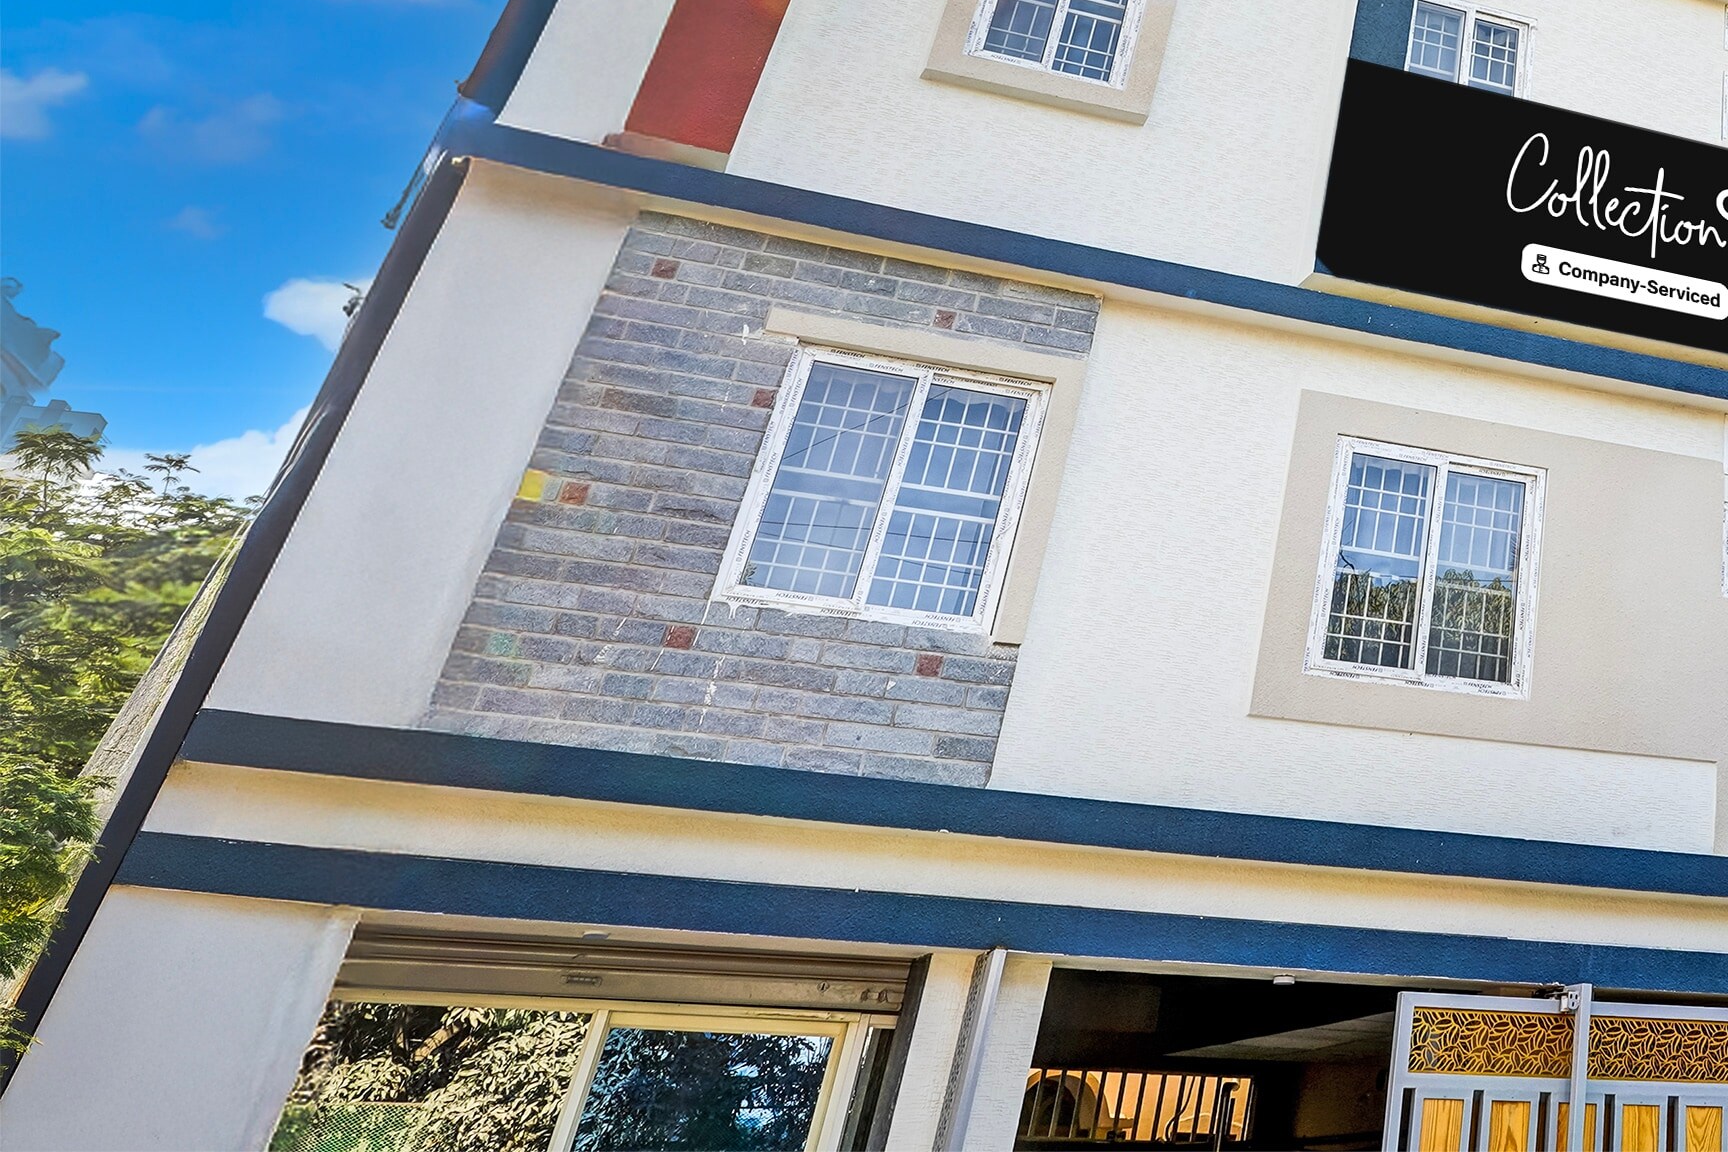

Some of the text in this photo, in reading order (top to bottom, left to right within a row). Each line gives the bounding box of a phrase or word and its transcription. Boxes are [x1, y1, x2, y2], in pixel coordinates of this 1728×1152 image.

[1506, 132, 1727, 259] Collection
[1558, 261, 1721, 309] Company-Serviced
[787, 348, 800, 374] FENSTECH
[835, 349, 865, 358] FENSTECH
[874, 363, 903, 372] FENSTECH
[919, 363, 950, 373] FENSTECH
[932, 376, 955, 385] NSTECH
[789, 377, 803, 403] FENSTECH
[1003, 377, 1032, 386] FENSTECH
[1010, 389, 1033, 397] FENSTE
[762, 420, 776, 446] FENSTECH
[764, 451, 778, 478] FENSTECH
[896, 440, 909, 467] FENSTECH
[1016, 439, 1027, 464] FENSTECH
[736, 528, 752, 556] FENSTECH
[873, 516, 886, 543] FENSTECH
[774, 592, 808, 600] FENSTECH
[978, 587, 990, 615] FENSTECH
[923, 613, 955, 622] FENSTECH
